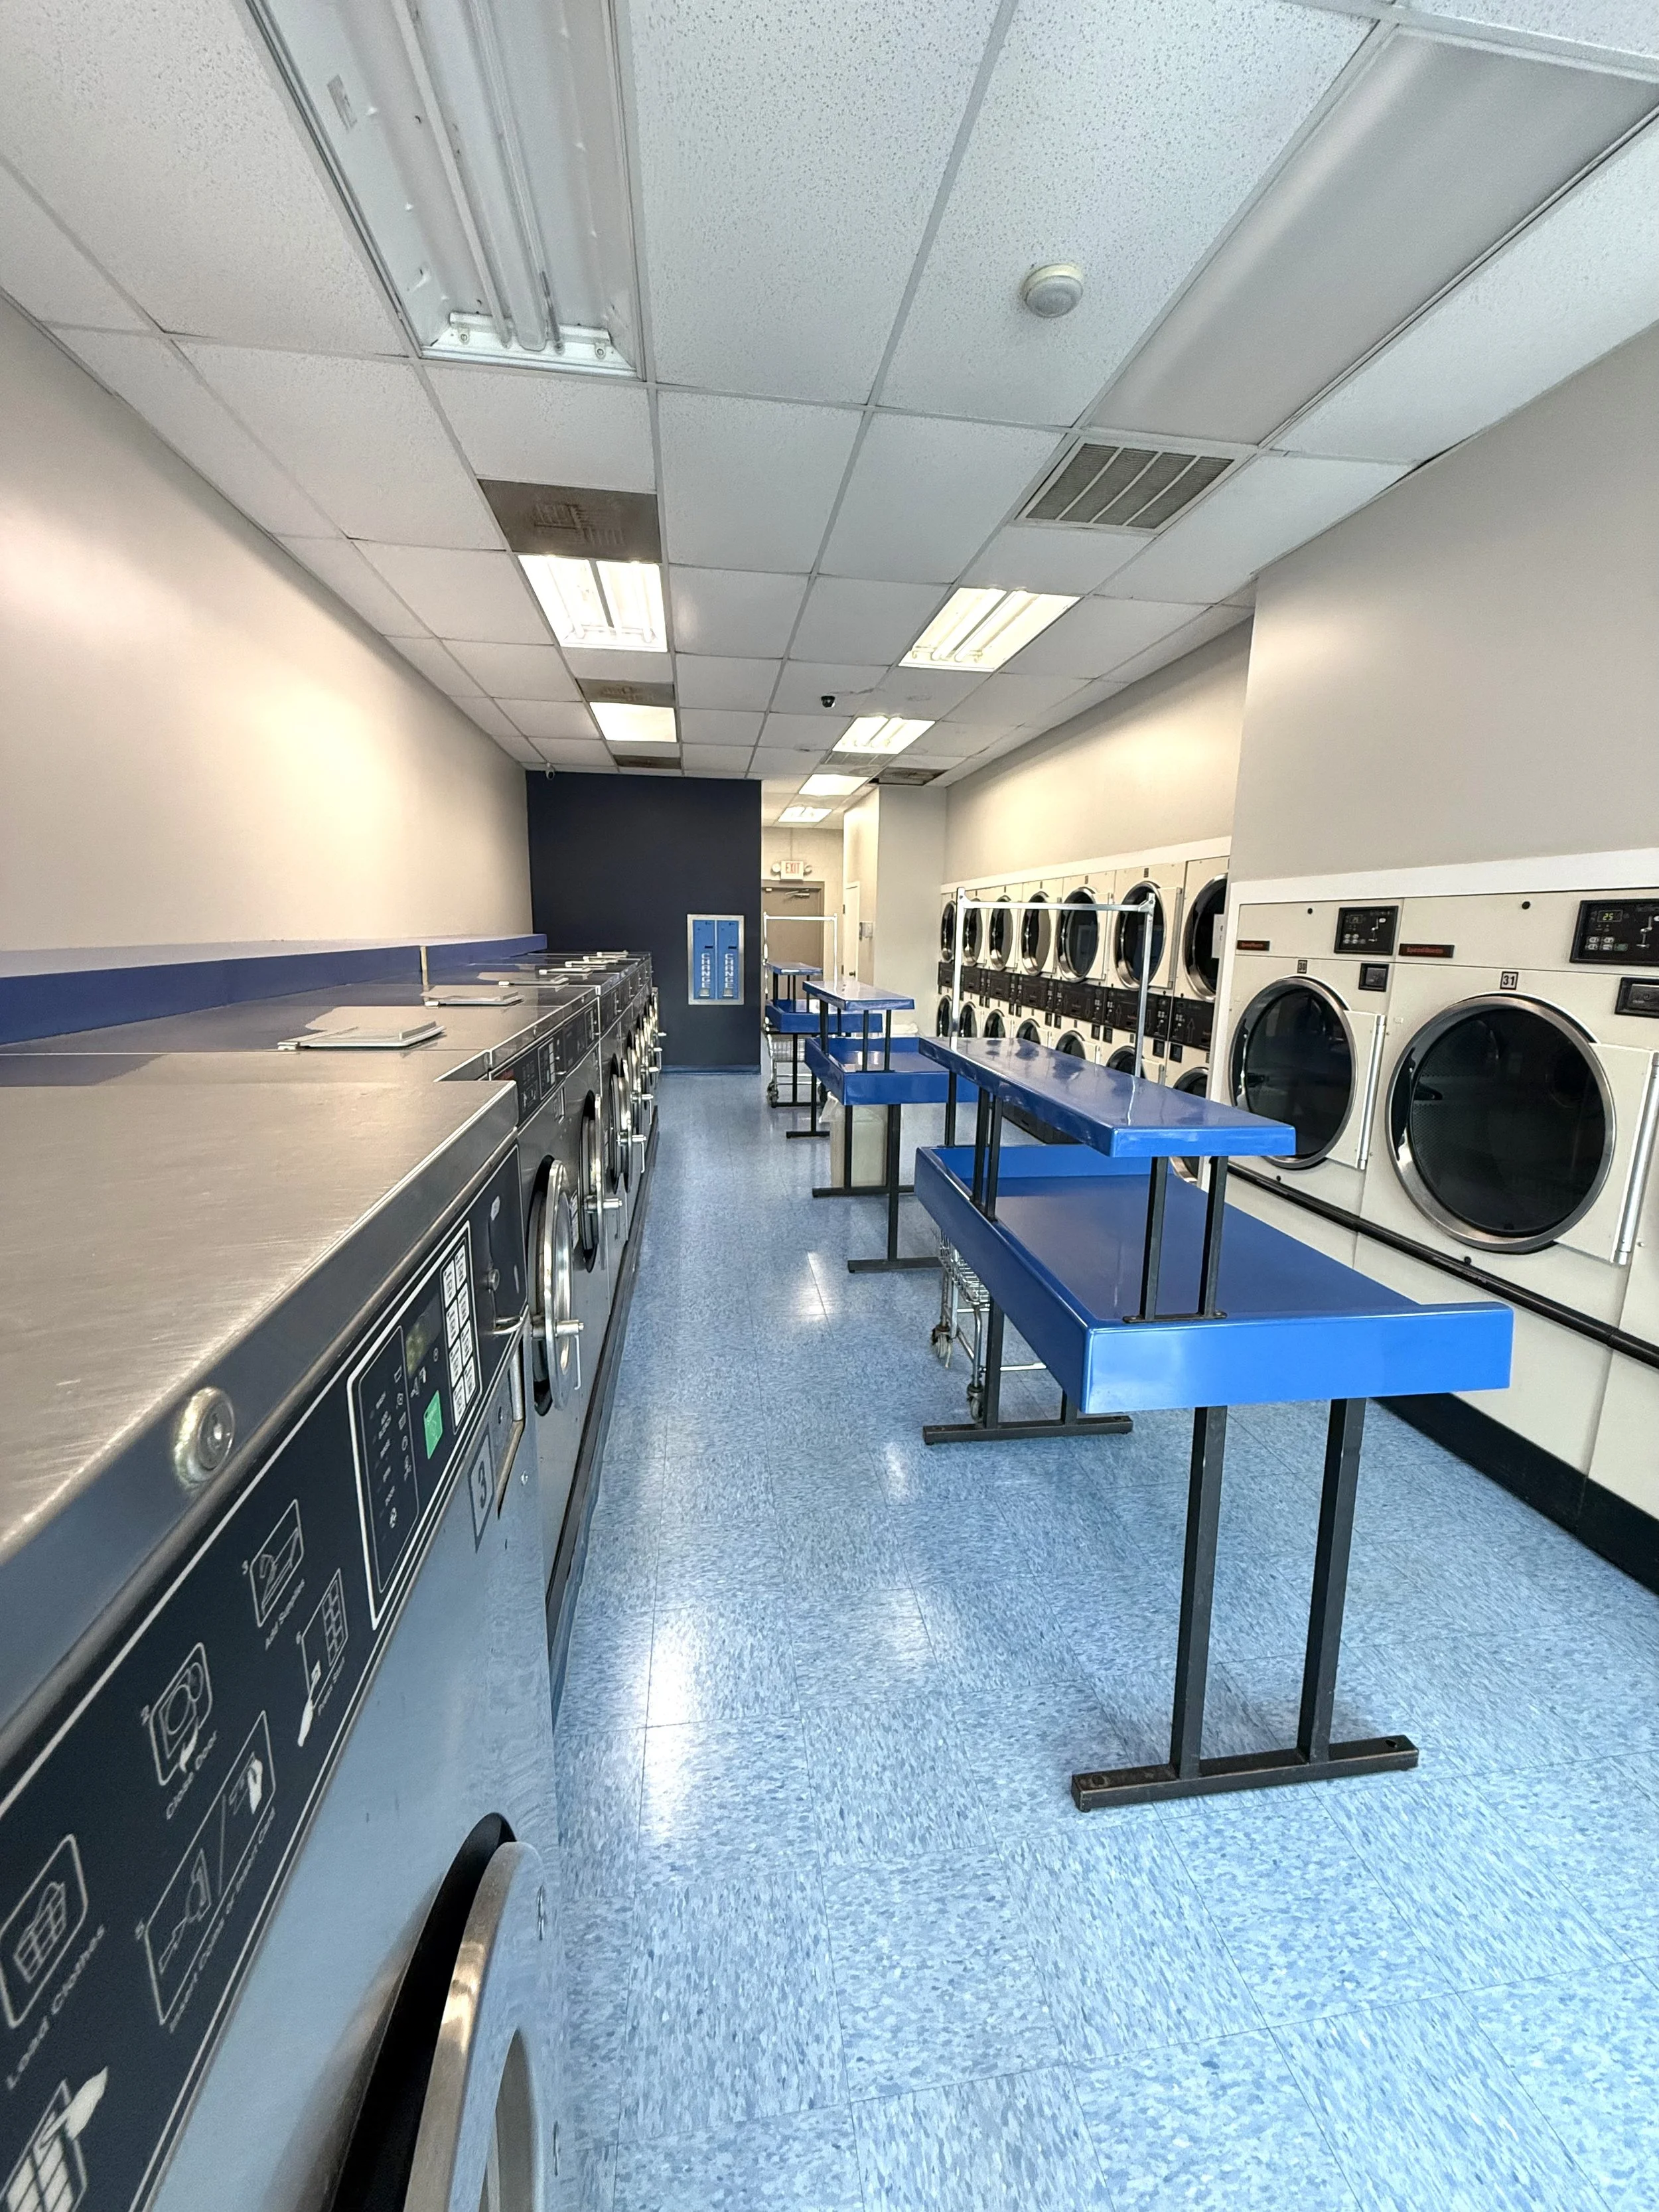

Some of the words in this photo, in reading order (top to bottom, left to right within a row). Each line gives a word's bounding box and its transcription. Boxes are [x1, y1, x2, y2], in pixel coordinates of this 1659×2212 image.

[785, 862, 800, 874] EXIT
[701, 952, 711, 988] CHANGE
[725, 953, 734, 989] CHANGE
[1503, 975, 1515, 986] 31
[478, 1460, 487, 1509] 3
[167, 1771, 194, 1820] Close
[195, 1730, 218, 1771] Door
[7, 2015, 49, 2090] Load
[51, 1924, 105, 2015] Clothes
